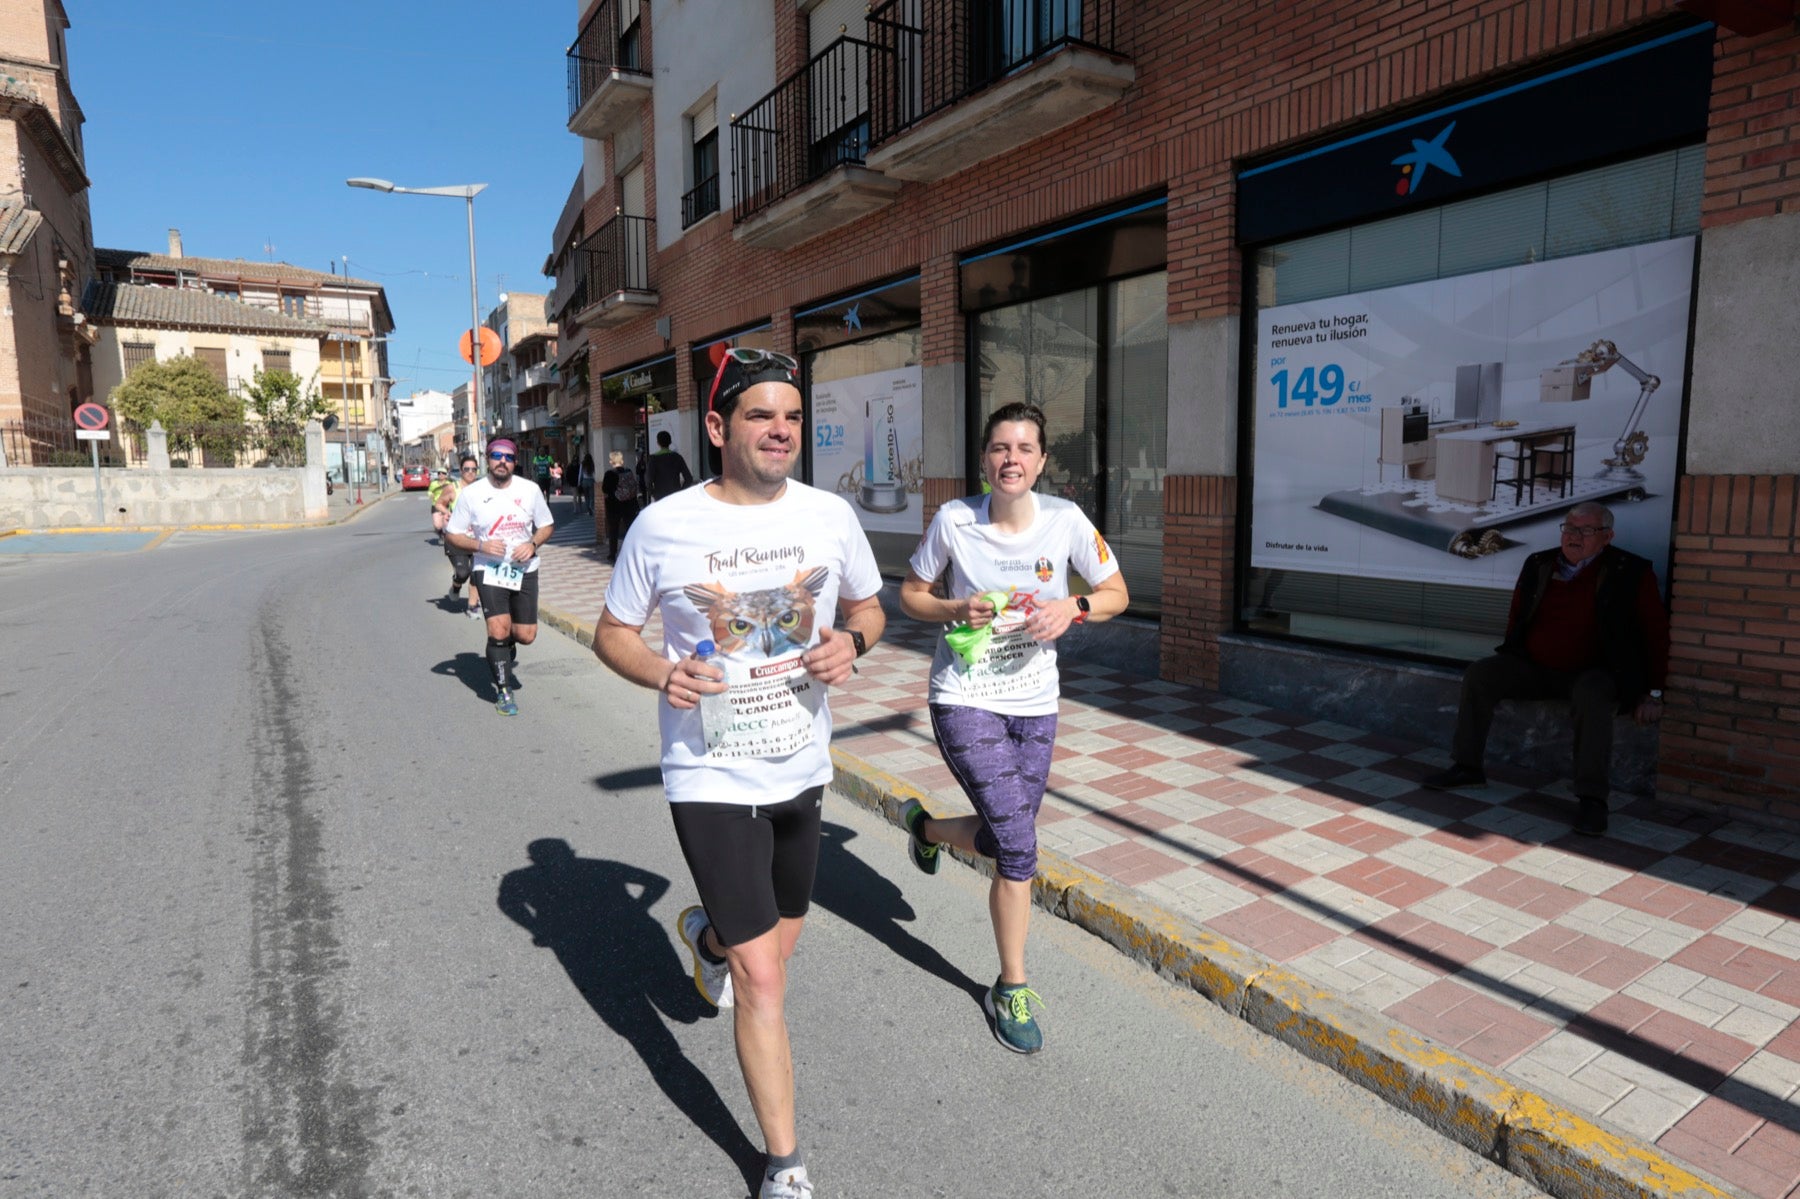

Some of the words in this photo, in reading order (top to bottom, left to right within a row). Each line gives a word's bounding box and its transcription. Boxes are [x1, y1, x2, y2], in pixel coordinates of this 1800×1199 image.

[1272, 320, 1316, 335] Renueva
[1319, 317, 1330, 329] tu
[1333, 313, 1369, 329] hogar,
[1271, 335, 1313, 348] renueva
[1316, 332, 1327, 342] tu
[1330, 327, 1367, 341] ilusión
[1271, 356, 1286, 368] por
[1270, 364, 1345, 409] 149
[1348, 393, 1372, 404] mes
[887, 404, 894, 424] 5G
[1265, 541, 1294, 550] Disfrutar
[1296, 543, 1304, 551] de
[1305, 543, 1312, 551] la
[1314, 544, 1329, 552] vida
[704, 547, 738, 574] Trail
[740, 545, 805, 564] Running
[493, 563, 518, 579] 115
[1003, 640, 1039, 652] CONTRA
[755, 659, 799, 677] Cruzcampo
[730, 694, 764, 706] ORRO
[766, 682, 811, 699] CONTRA
[745, 699, 793, 716] CANCER
